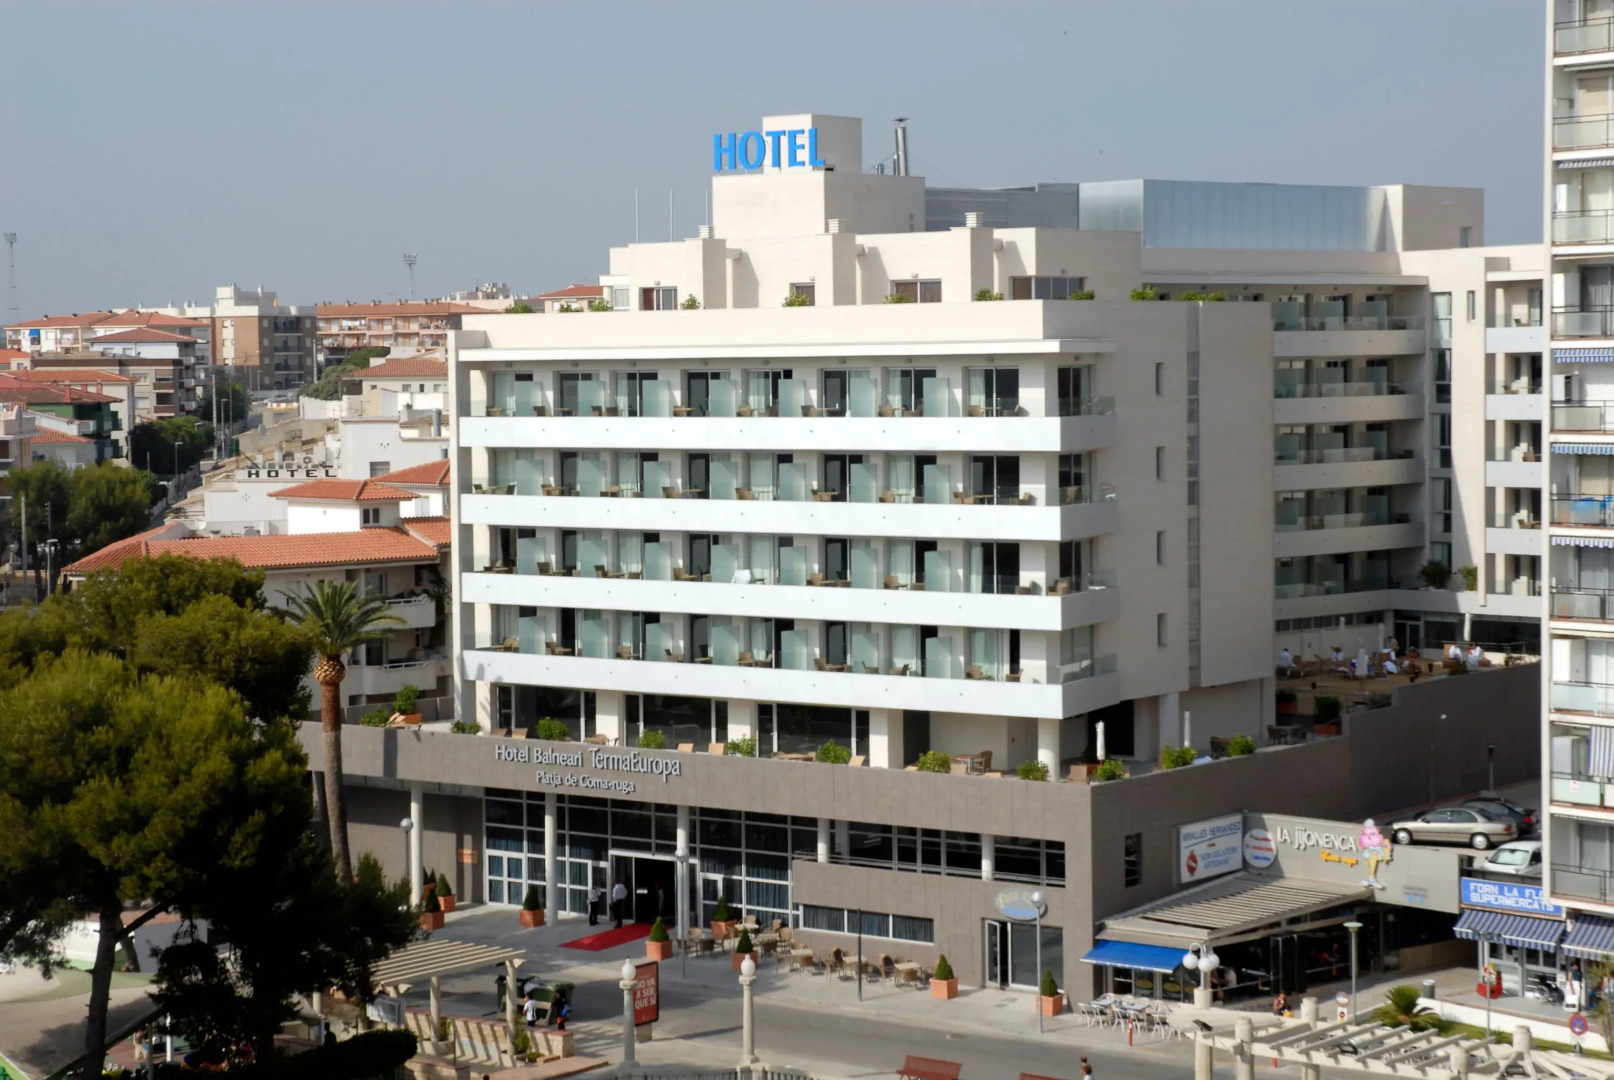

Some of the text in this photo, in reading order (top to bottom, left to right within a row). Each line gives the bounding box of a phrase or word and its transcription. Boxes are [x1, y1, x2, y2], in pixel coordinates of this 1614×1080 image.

[713, 128, 826, 171] HOTEL
[247, 469, 337, 478] HOTEL
[495, 745, 681, 783] Hotel Balneari TermaEuropa
[536, 771, 562, 787] Platja
[565, 774, 578, 787] de
[1277, 826, 1291, 843] LA
[1470, 882, 1499, 896] FORN
[1504, 886, 1519, 897] LA
[1470, 893, 1554, 911] SUPERMERCATS
[647, 978, 656, 987] VA
[642, 987, 655, 998] SER
[635, 1000, 648, 1010] QUE
